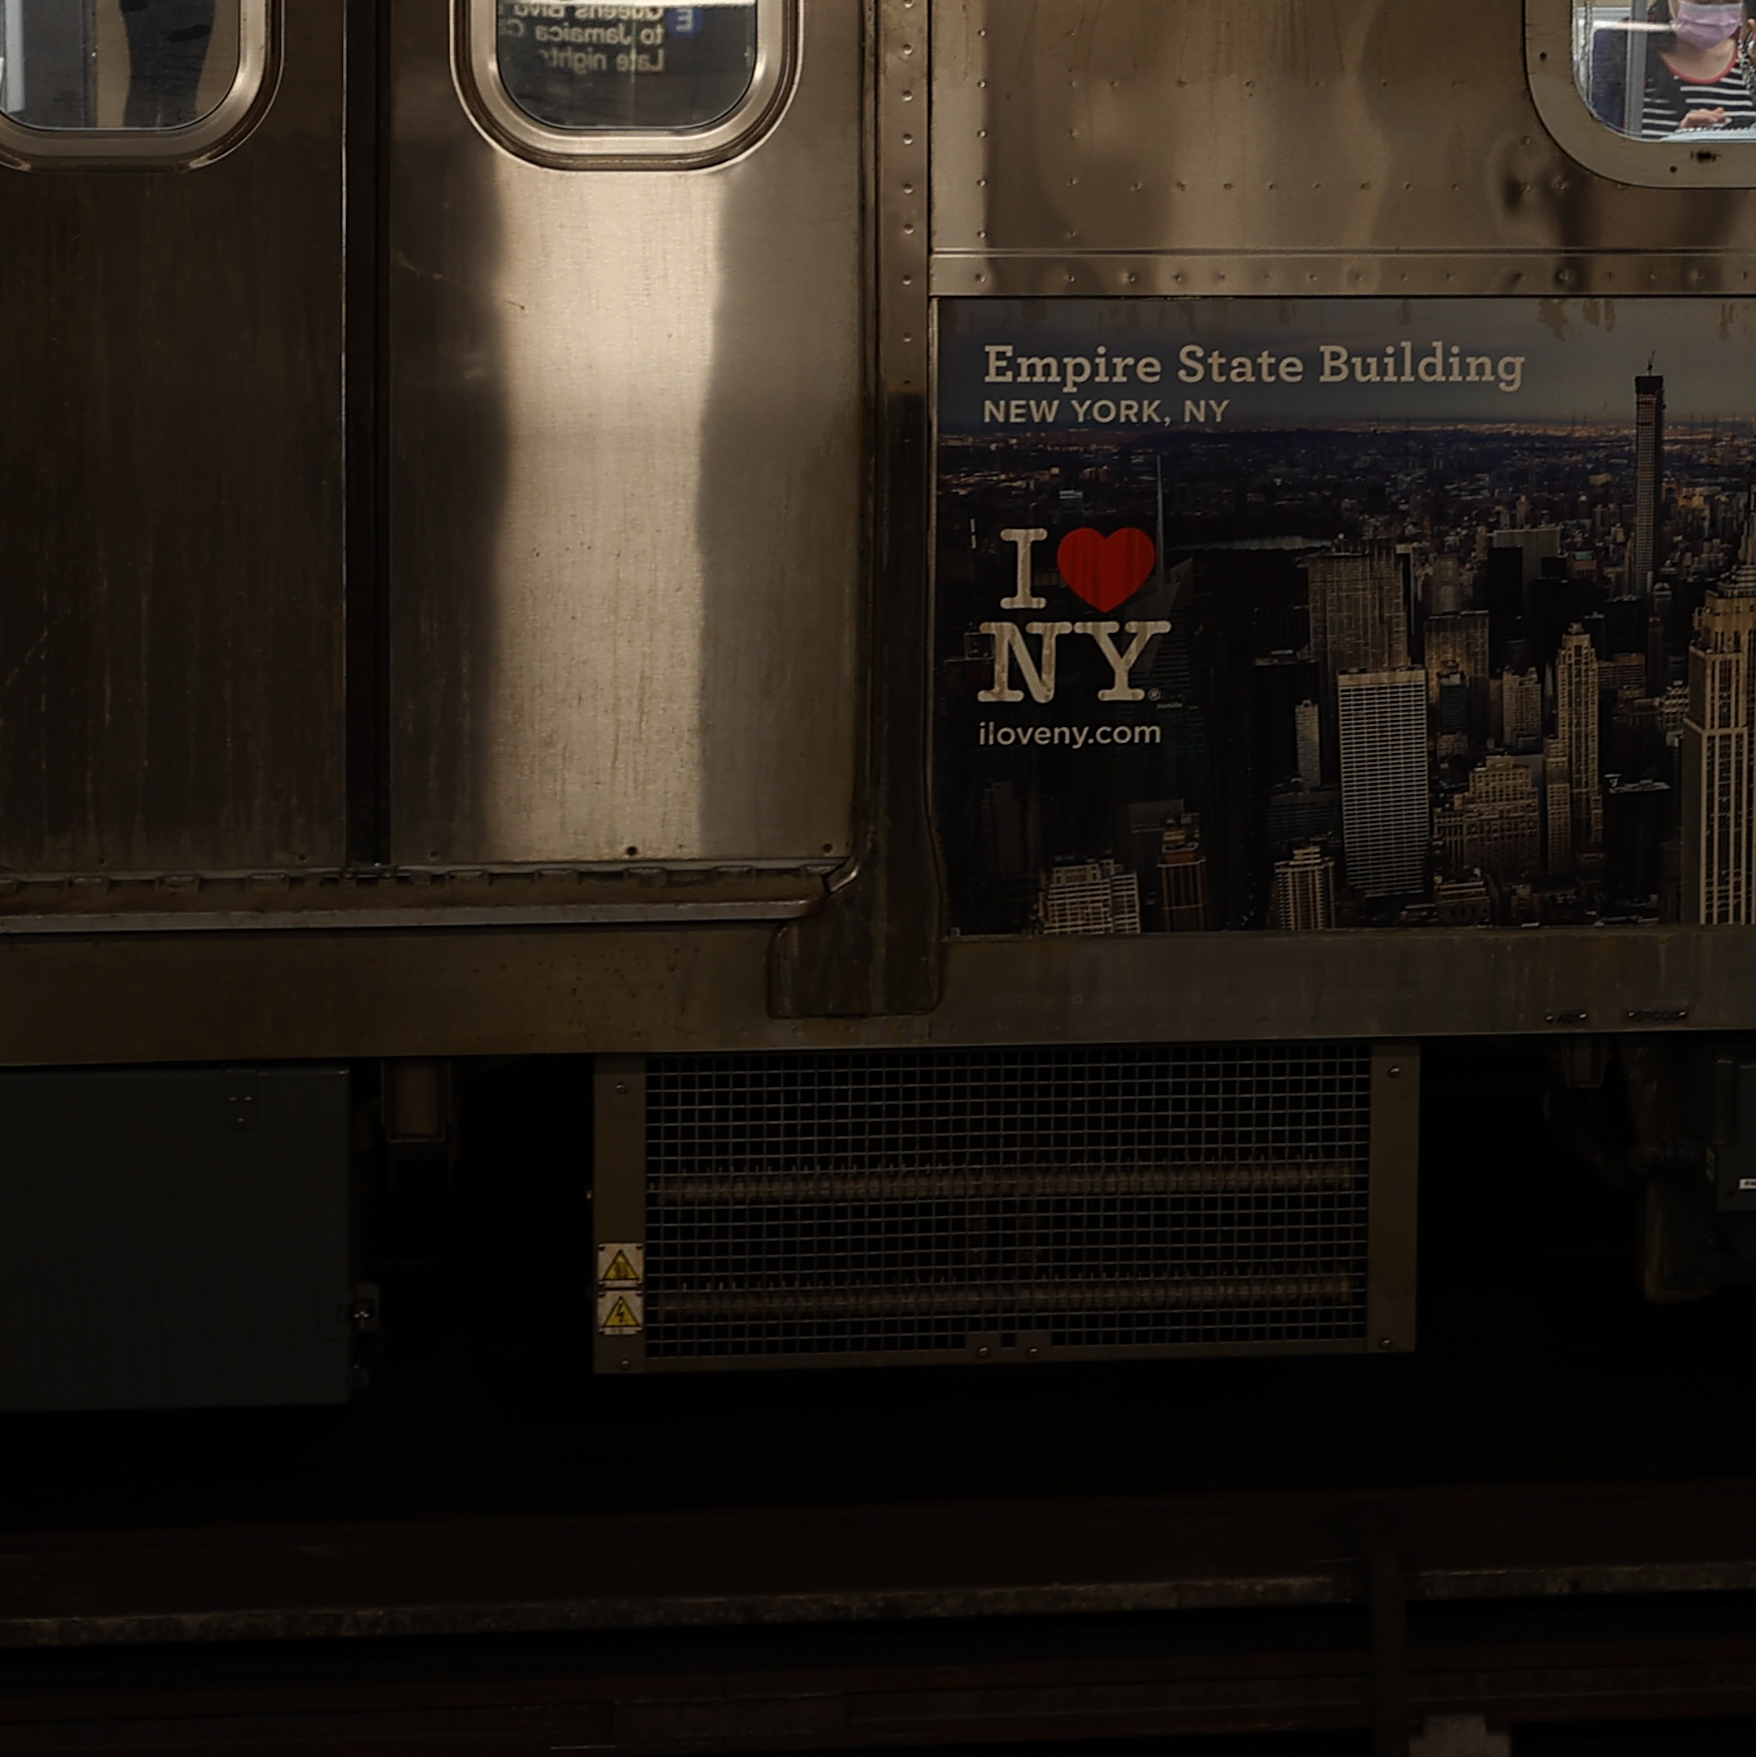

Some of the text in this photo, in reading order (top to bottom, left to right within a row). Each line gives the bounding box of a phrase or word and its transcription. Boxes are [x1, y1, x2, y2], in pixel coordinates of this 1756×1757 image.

[983, 340, 1526, 394] Empire State Building
[982, 399, 1231, 427] NEW YORK, NY
[999, 527, 1049, 610] I
[976, 620, 1173, 704] NY
[977, 720, 1163, 750] iloveny.com
